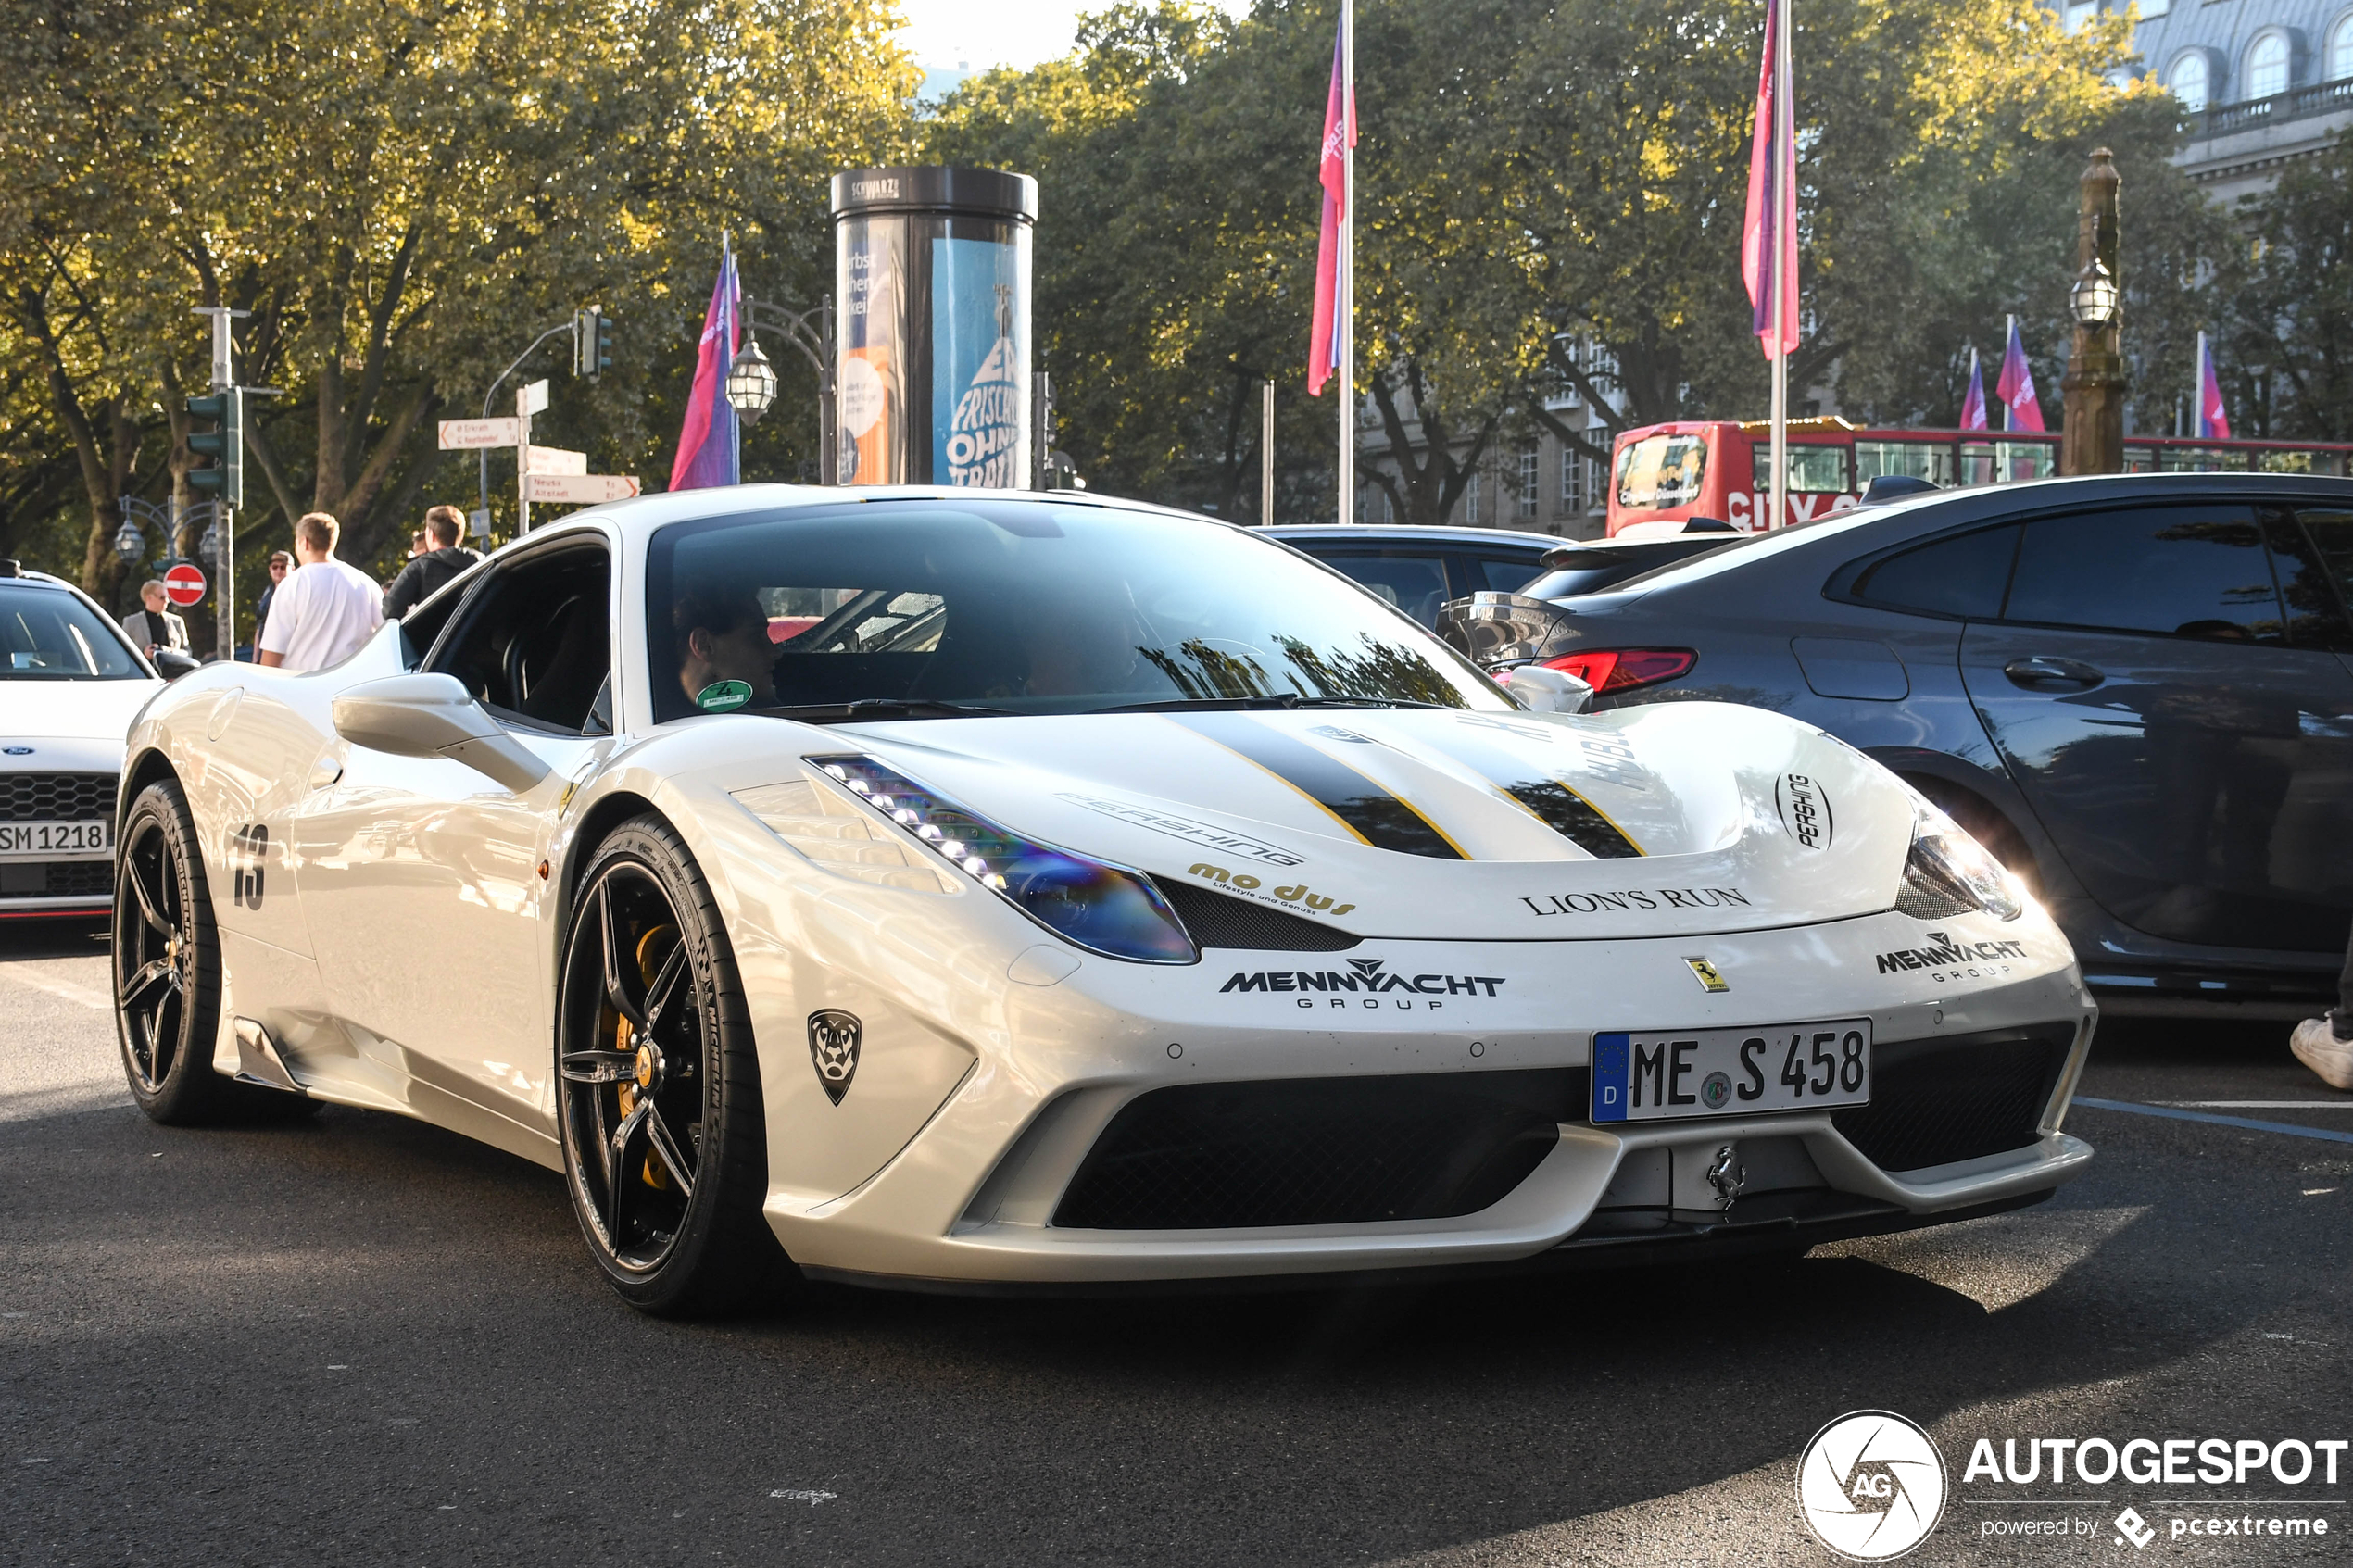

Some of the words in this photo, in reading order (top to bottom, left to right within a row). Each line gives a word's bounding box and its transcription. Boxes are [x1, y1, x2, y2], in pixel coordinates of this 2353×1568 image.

[1788, 773, 1820, 850] PERSHING
[38, 825, 102, 849] 1218
[1052, 792, 1306, 868] PERSHING
[1213, 882, 1255, 897] Lifestyle
[1258, 895, 1278, 905] und
[1280, 900, 1316, 916] Genuss
[1656, 887, 1752, 908] RUN
[1876, 940, 2028, 974] MENNYACHT
[1218, 972, 1506, 997] MENNYACHT
[1931, 965, 2010, 983] GROUP
[1297, 998, 1442, 1010] GROUP
[707, 1005, 721, 1108] MICHELIN
[1632, 1040, 1698, 1108] ME
[1737, 1037, 1766, 1100] S
[1781, 1030, 1864, 1097] 458
[1604, 1085, 1617, 1105] D
